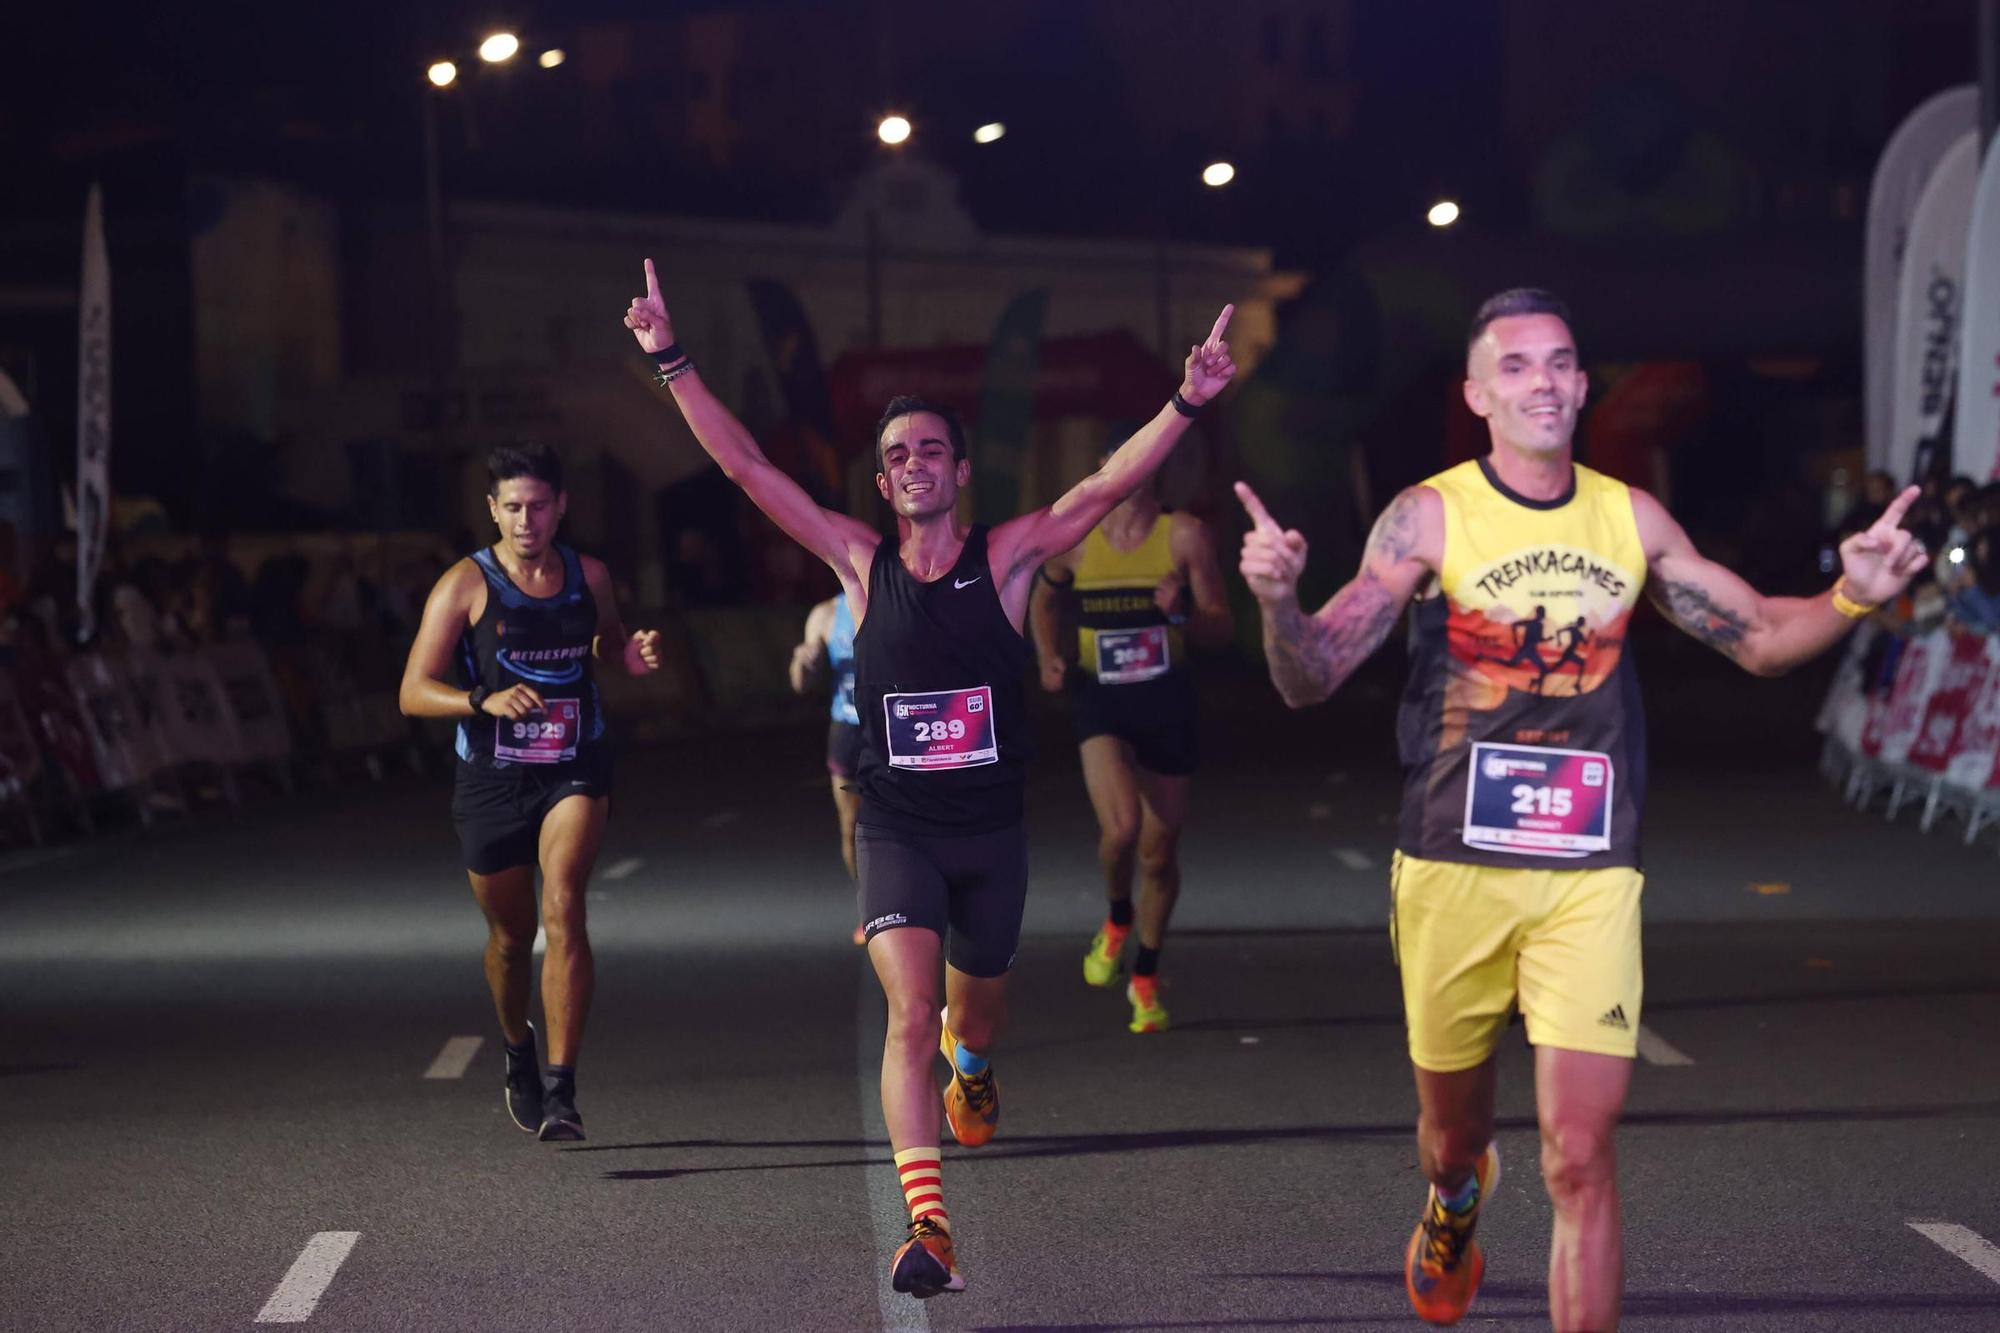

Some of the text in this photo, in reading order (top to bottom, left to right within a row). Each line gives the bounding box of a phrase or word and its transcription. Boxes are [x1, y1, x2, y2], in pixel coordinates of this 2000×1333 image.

[1476, 550, 1626, 598] TRENKACAMES
[513, 722, 566, 739] 9929
[914, 719, 965, 742] 289
[928, 744, 955, 752] ALBERT
[1511, 784, 1573, 816] 215
